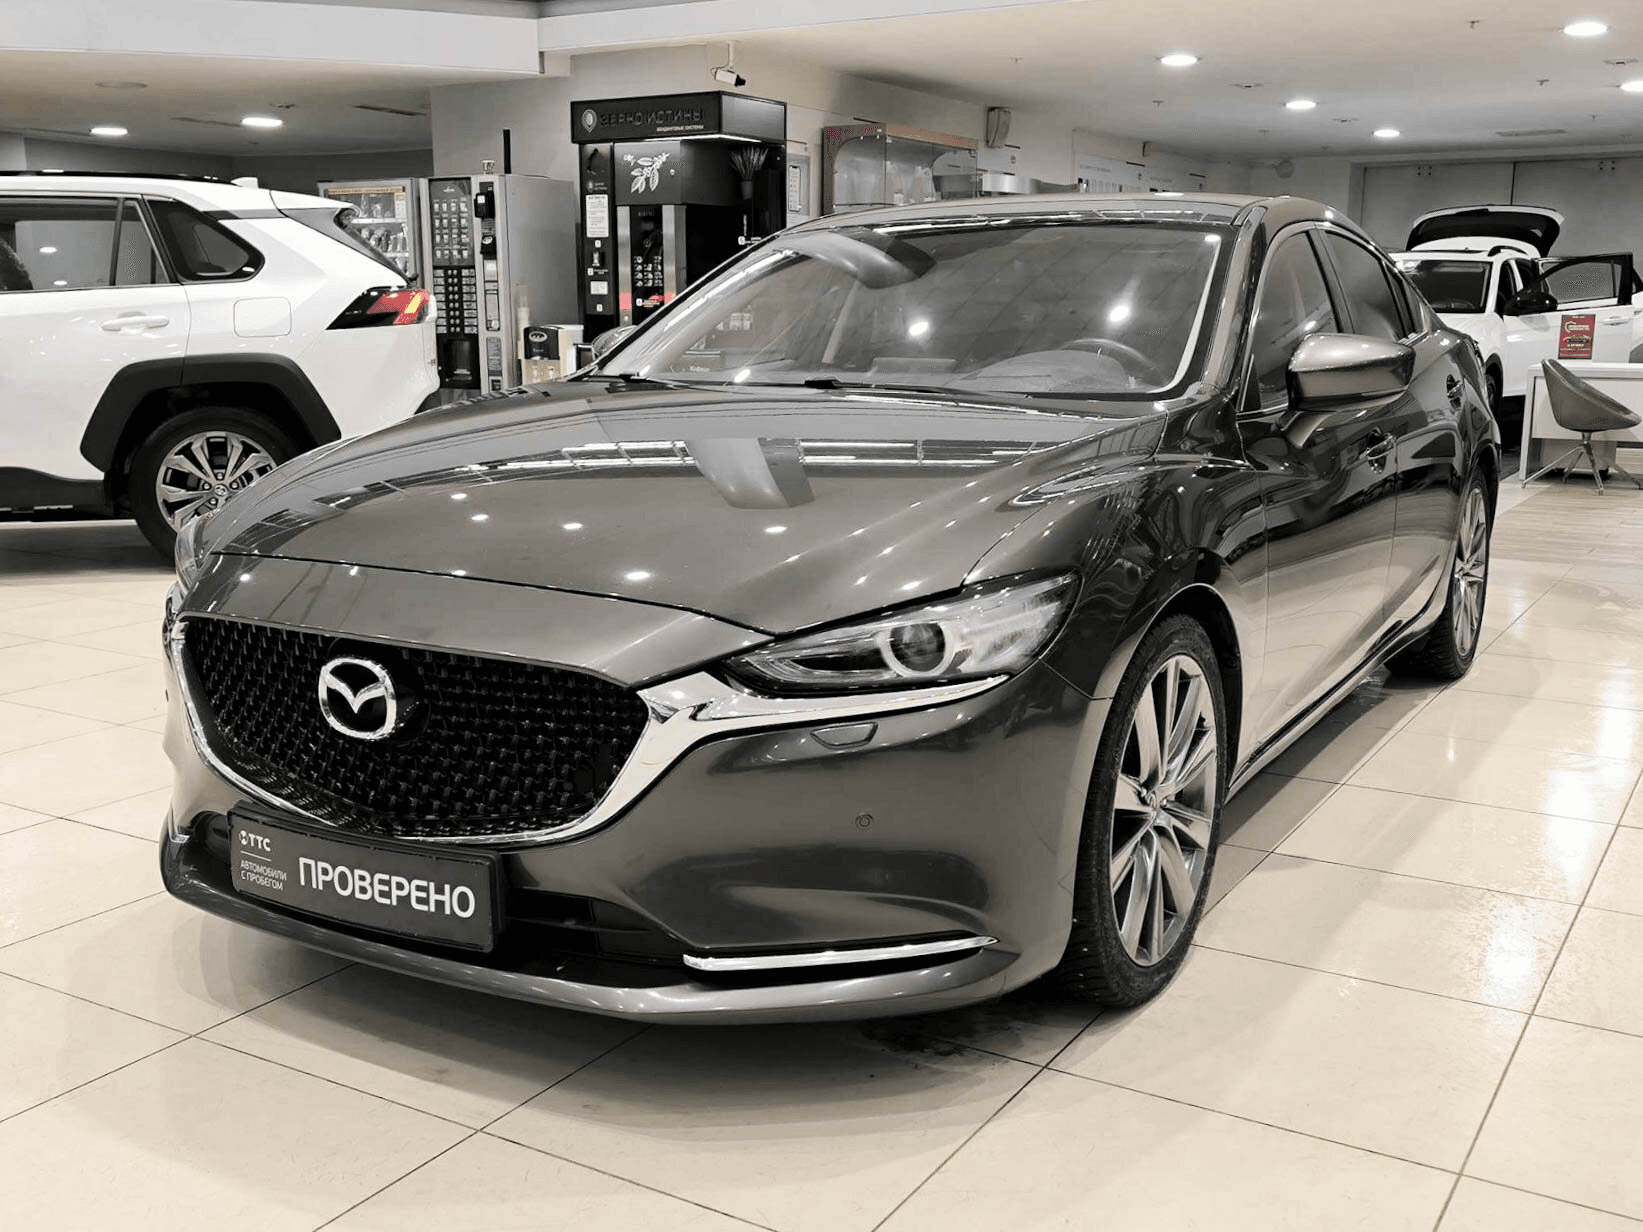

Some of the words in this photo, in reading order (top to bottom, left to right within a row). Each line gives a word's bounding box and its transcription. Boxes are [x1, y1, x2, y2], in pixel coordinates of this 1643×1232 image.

[600, 111, 643, 127] ЗЕРНО
[646, 108, 703, 124] ИСТИНЫ
[248, 833, 271, 851] ТТС
[240, 860, 287, 881] АВТОМОБИЛИ
[240, 870, 246, 880] С
[246, 872, 283, 891] ПРОБЕГОМ
[298, 857, 476, 919] ПРОВЕРЕНО
